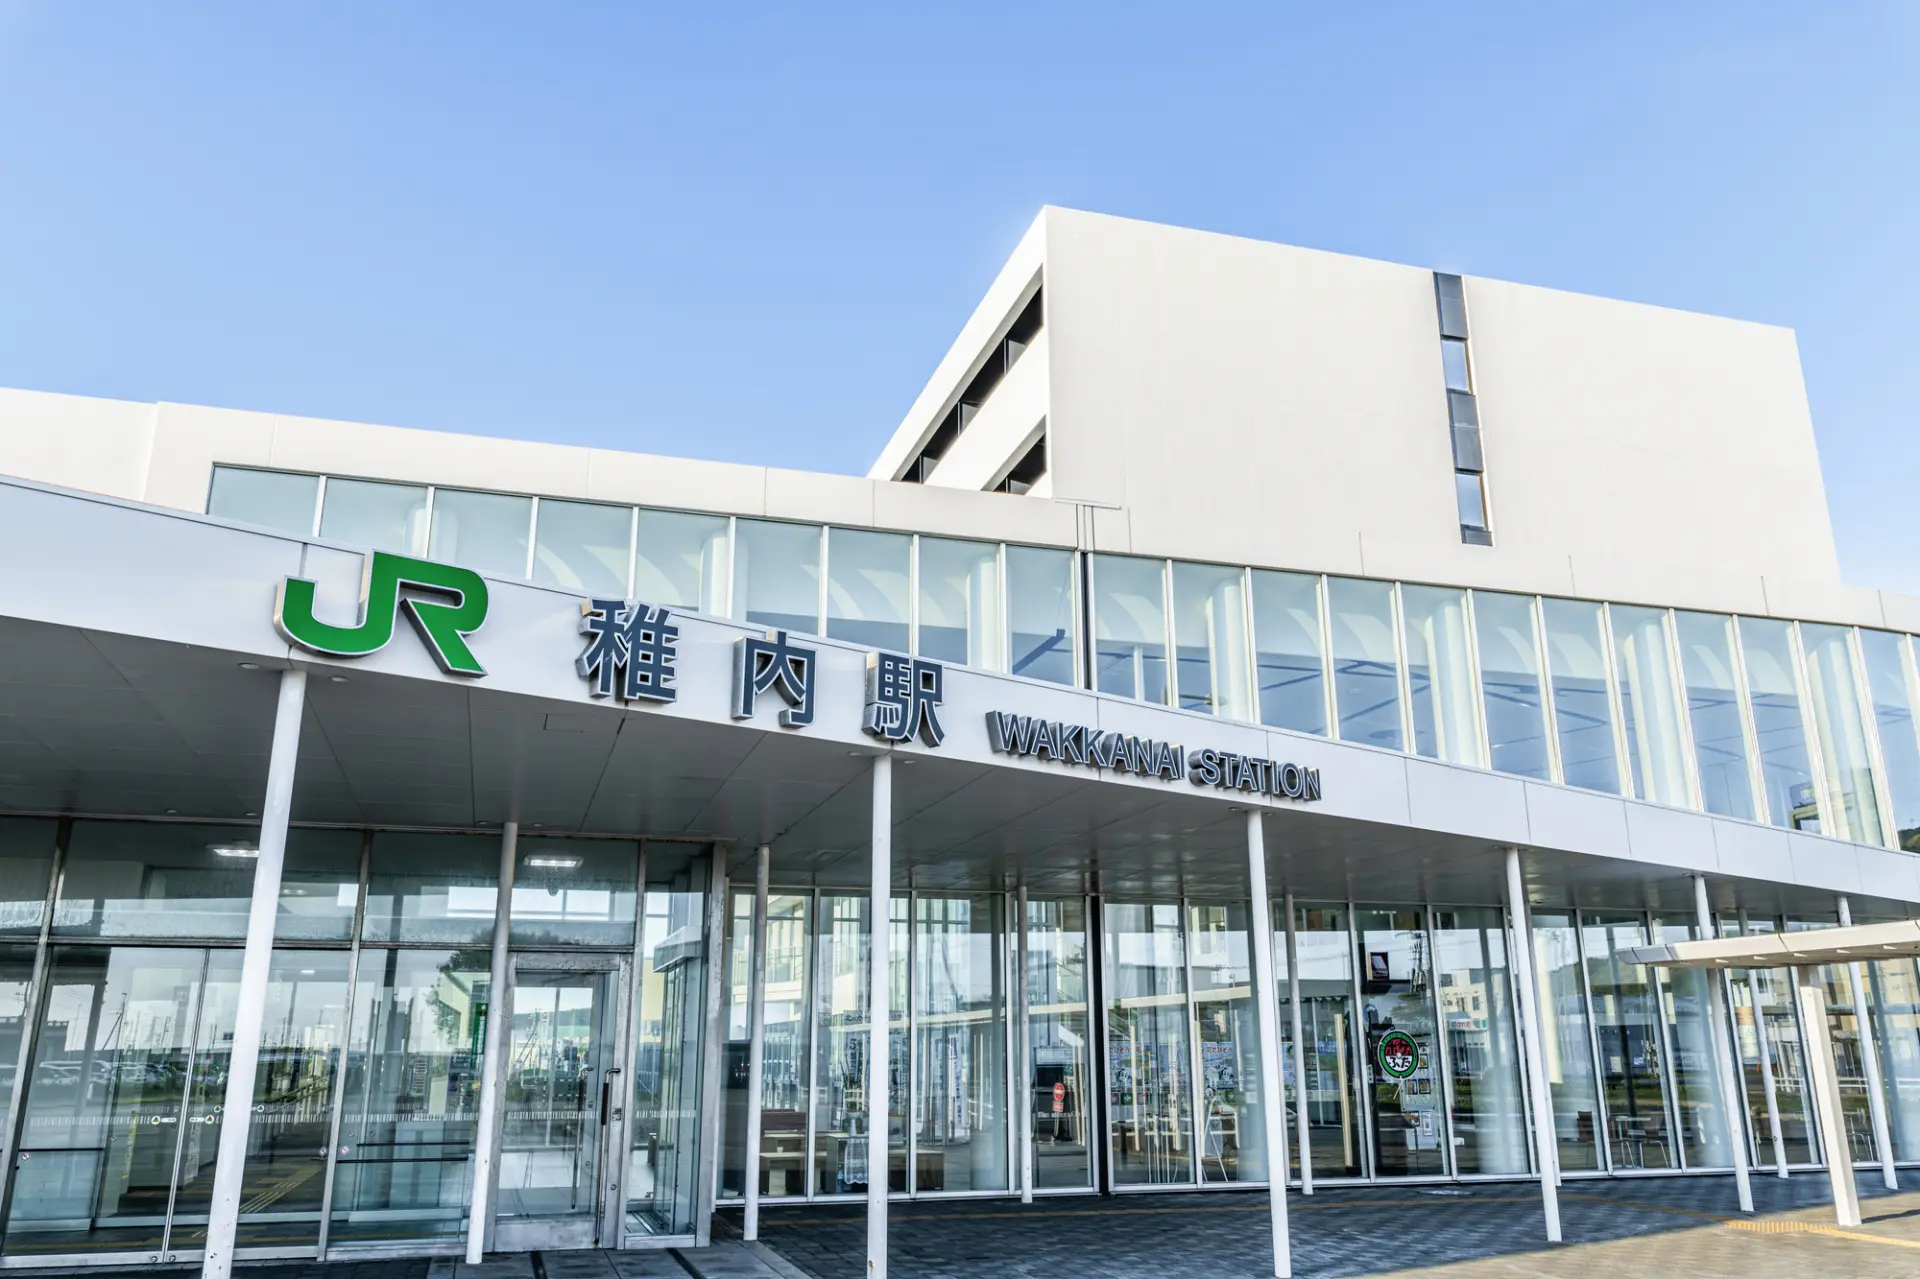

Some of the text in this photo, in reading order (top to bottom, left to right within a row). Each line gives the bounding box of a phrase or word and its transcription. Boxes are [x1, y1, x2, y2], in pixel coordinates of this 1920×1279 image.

[274, 549, 489, 679] JR
[577, 597, 946, 748] 稚内駅
[987, 711, 1322, 801] WAKKANAI STATION
[1388, 1056, 1411, 1069] ふた
